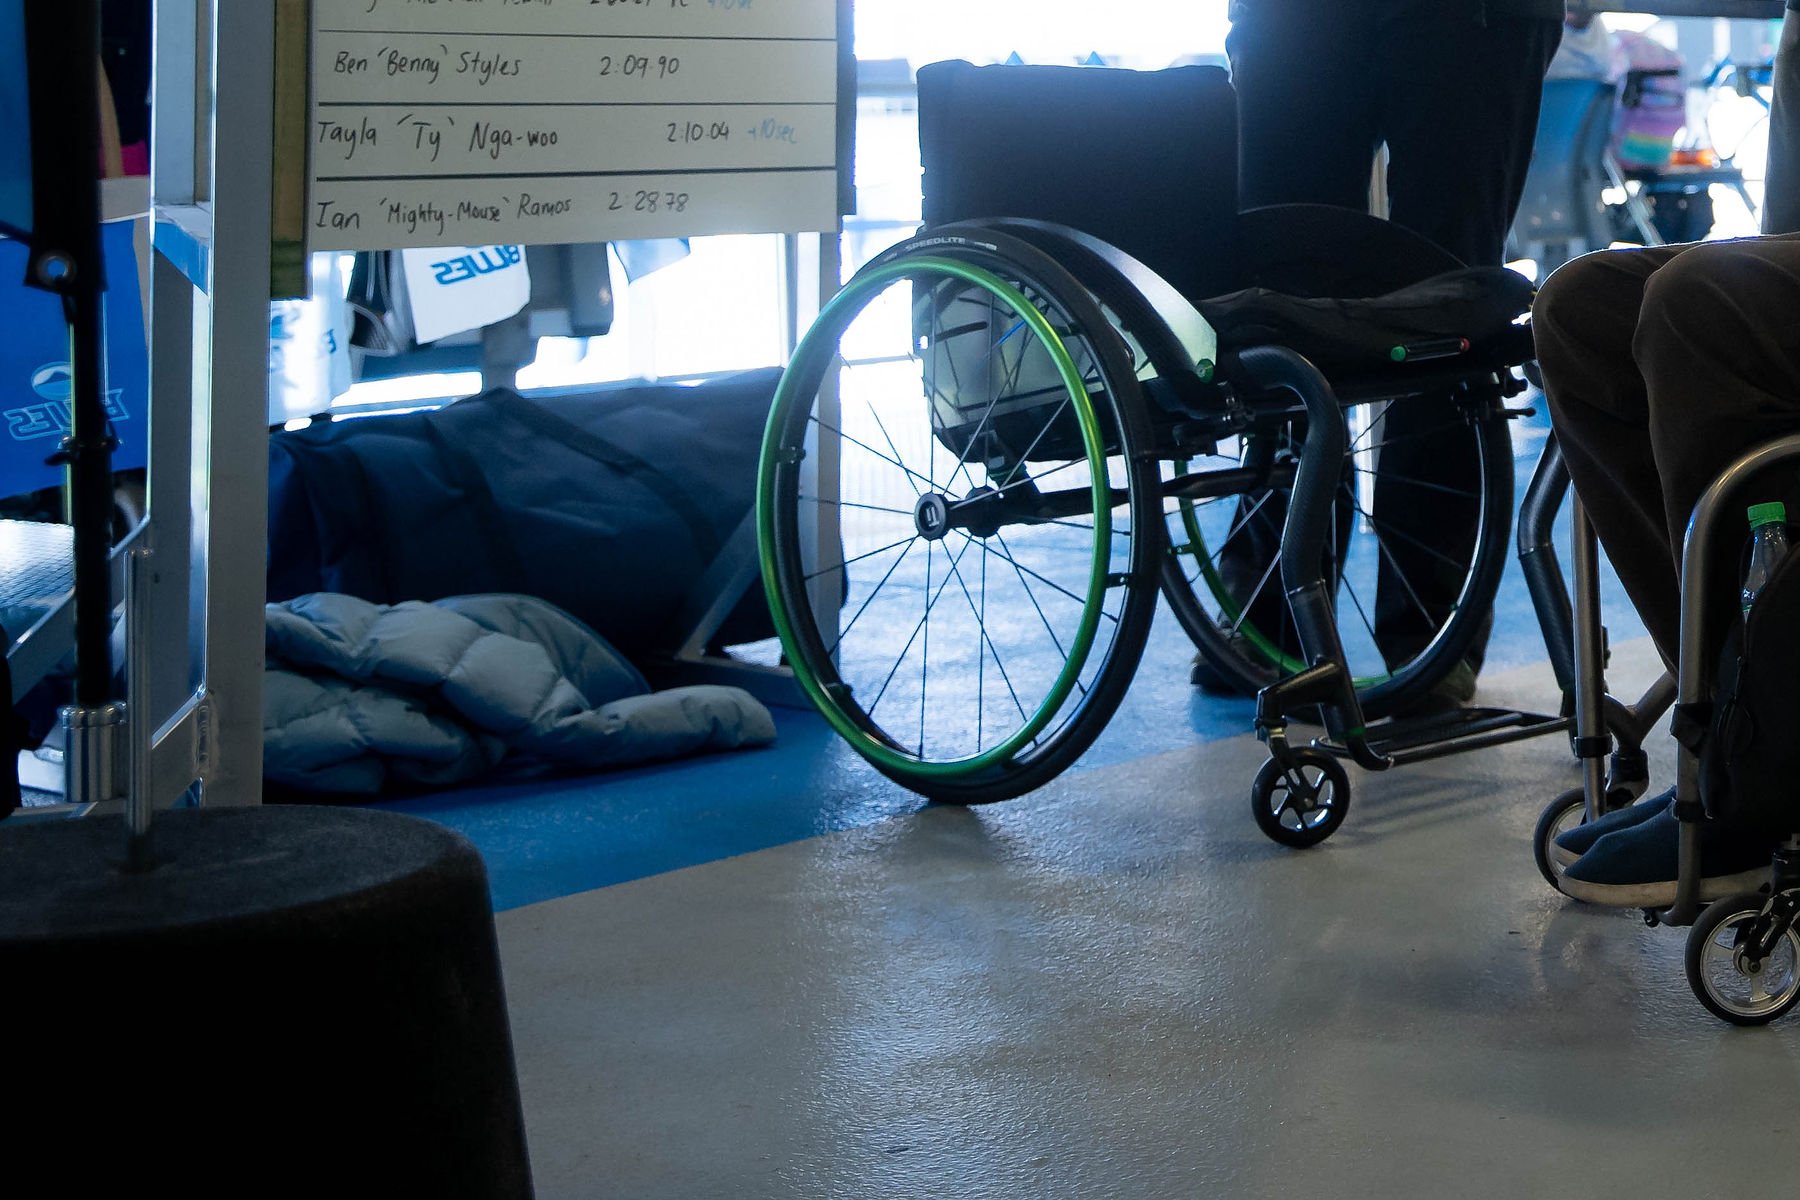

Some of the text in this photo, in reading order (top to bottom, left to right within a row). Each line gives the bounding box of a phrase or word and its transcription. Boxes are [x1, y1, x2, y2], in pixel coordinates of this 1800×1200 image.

[334, 50, 367, 74] Ben
[455, 51, 522, 86] Styles
[317, 116, 377, 160] Tayla
[469, 121, 558, 160] Nga-woo
[316, 200, 360, 230] Ian
[516, 193, 572, 219] Ramos
[904, 235, 967, 251] SPEEDLITE
